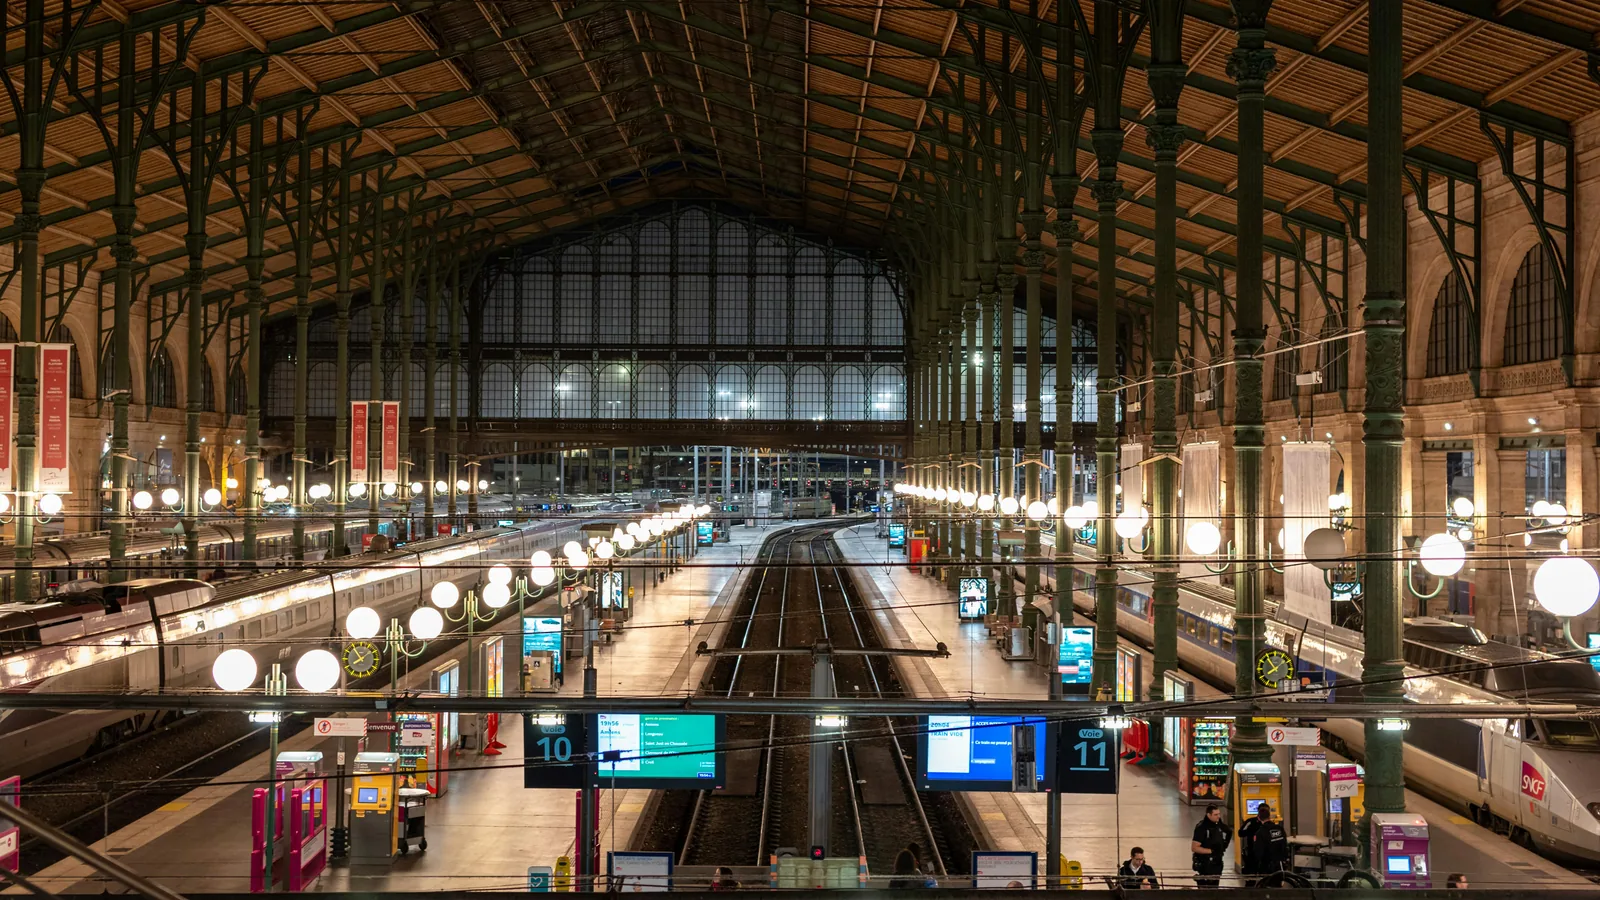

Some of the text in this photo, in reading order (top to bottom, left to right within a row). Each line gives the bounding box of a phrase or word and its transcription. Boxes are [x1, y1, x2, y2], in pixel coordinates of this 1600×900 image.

[366, 723, 396, 731] ienvenue
[544, 725, 562, 733] Voie
[536, 736, 572, 762] 10
[1073, 741, 1106, 766] 11
[1522, 774, 1545, 795] SNCF
